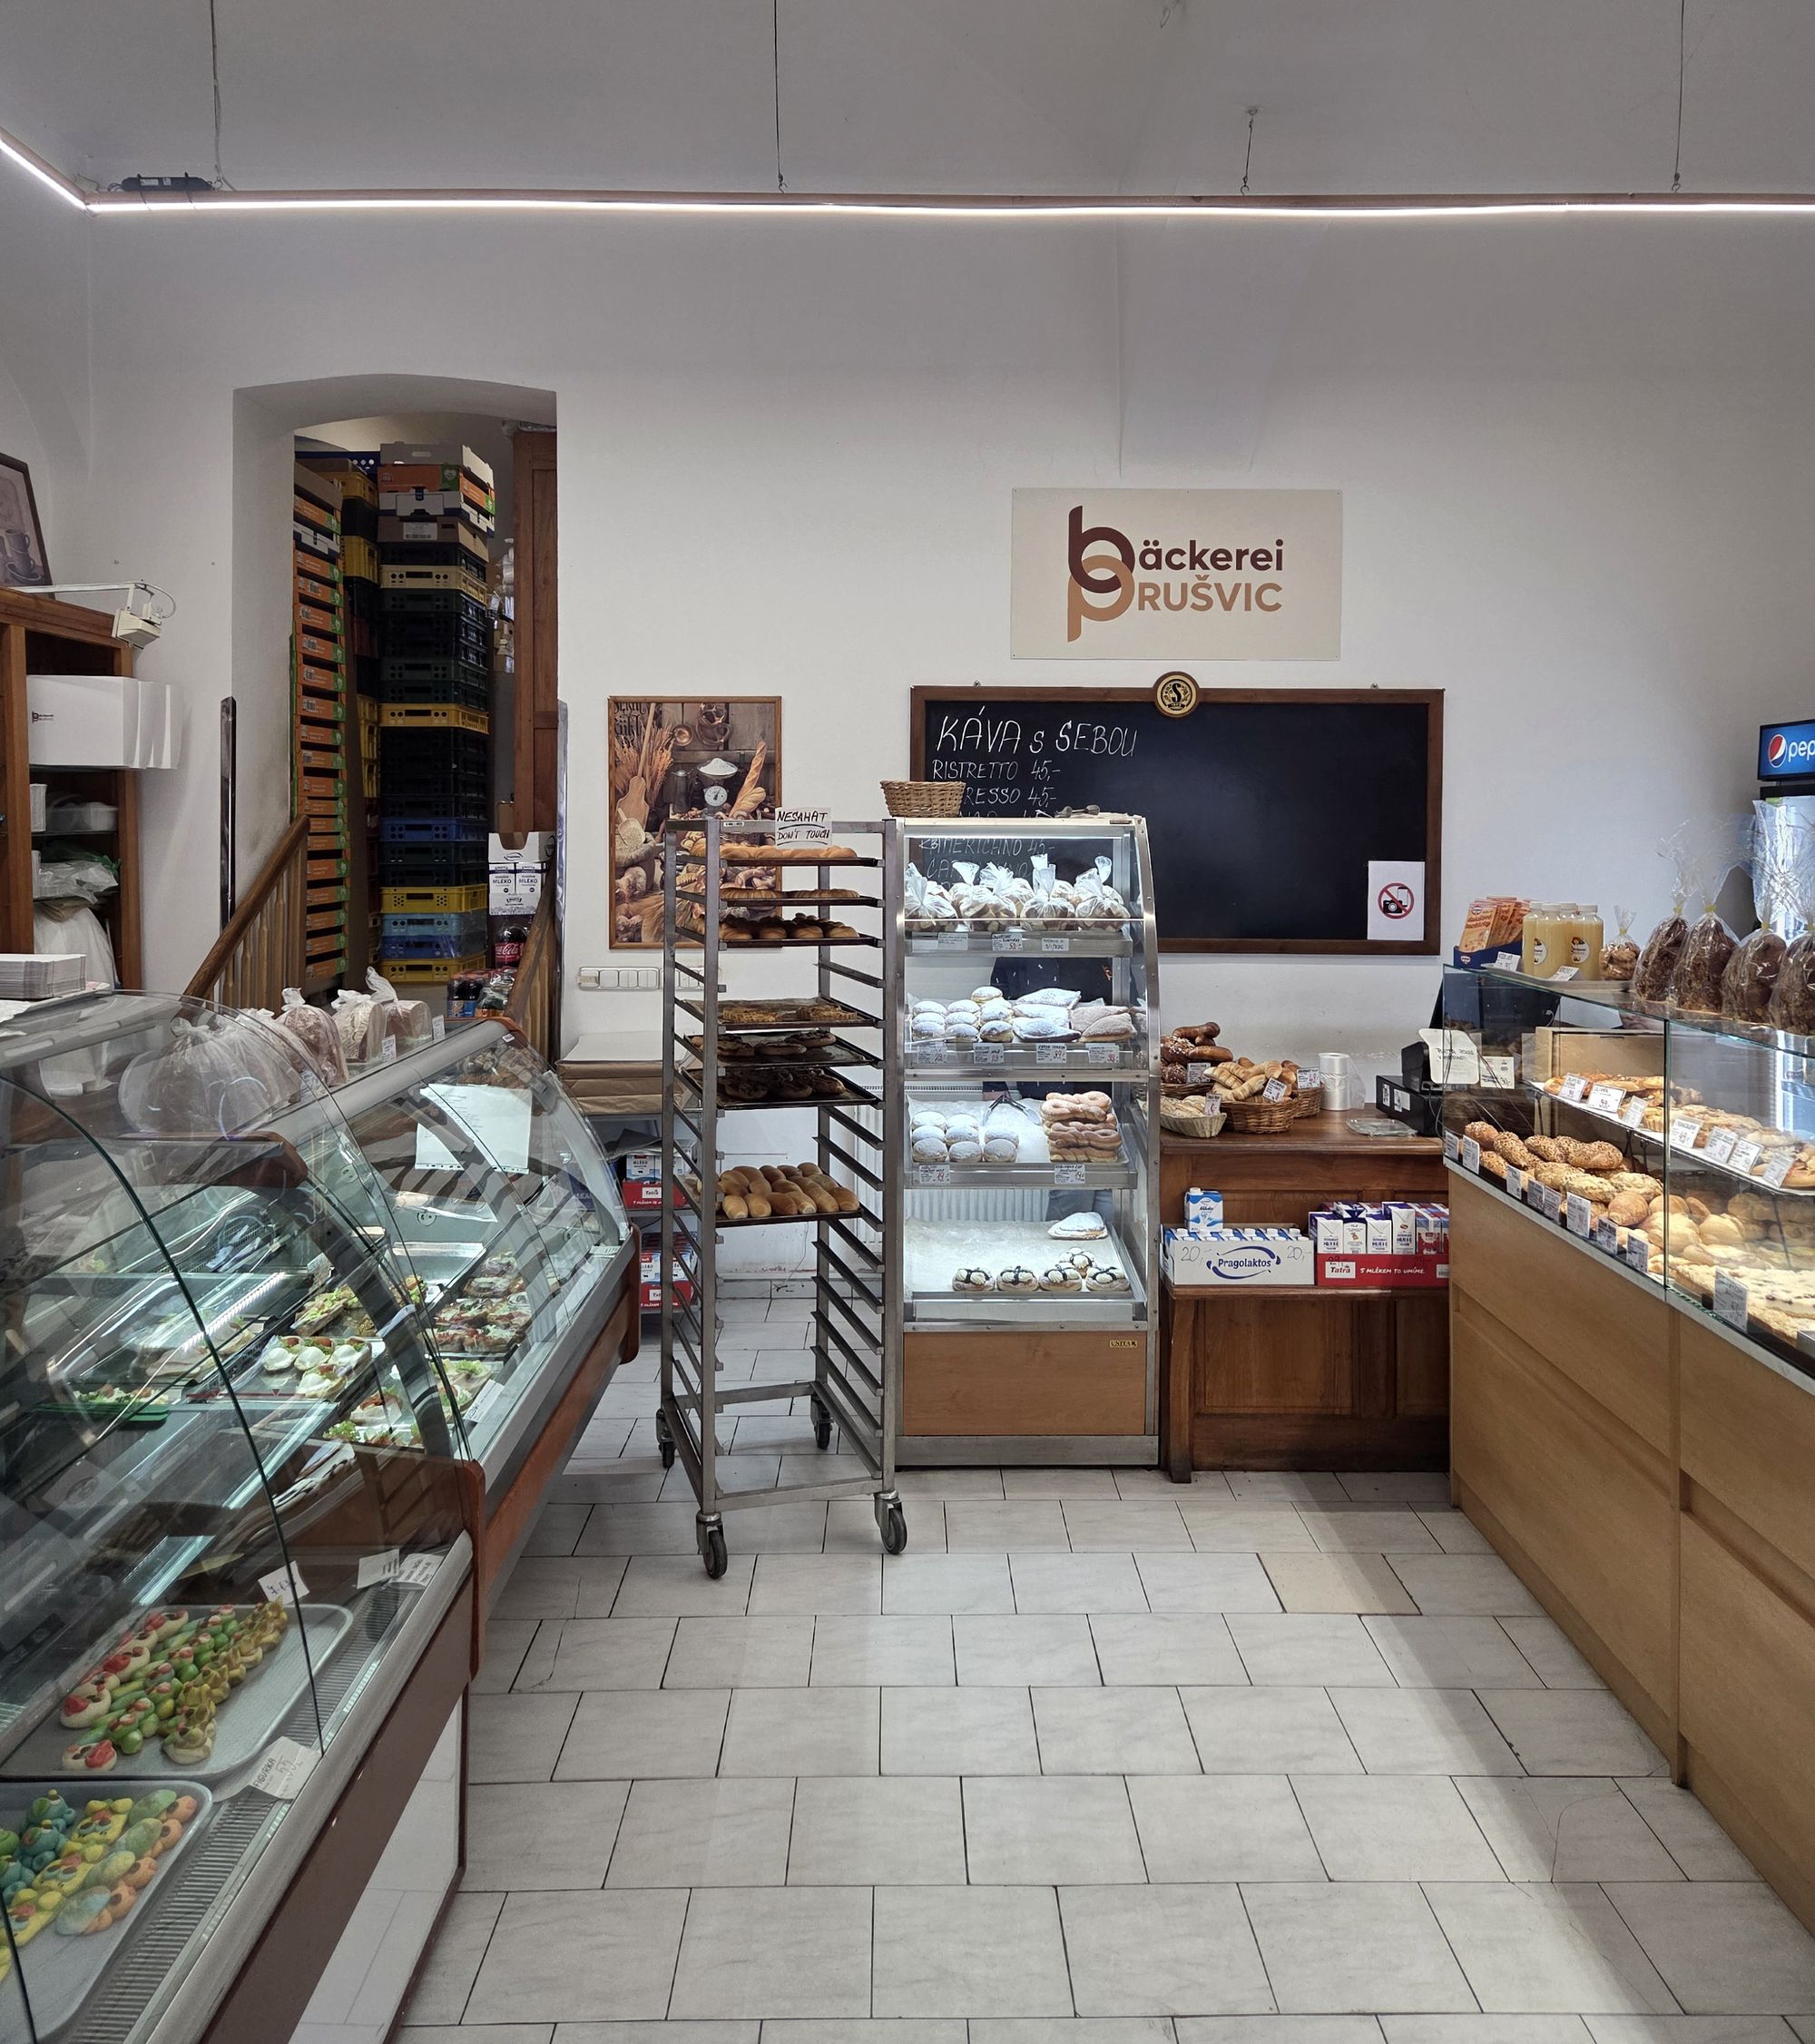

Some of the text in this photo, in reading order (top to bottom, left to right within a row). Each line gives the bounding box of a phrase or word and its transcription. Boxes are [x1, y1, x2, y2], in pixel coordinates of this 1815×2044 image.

[1068, 505, 1284, 594] bäckerei
[937, 705, 1021, 753] KÁVA
[1055, 720, 1137, 757] SEBOU
[932, 759, 1061, 782] RISTRETTO 45,-
[964, 786, 1057, 808] RESSO 45,-
[777, 811, 828, 822] NESAHAT
[777, 829, 829, 840] DON'T TOUCH
[1181, 1246, 1212, 1265] 20,-
[1218, 1258, 1271, 1270] Pragolaktos
[1287, 1245, 1311, 1263] 20,-
[253, 1757, 276, 1787] FIGURKA
